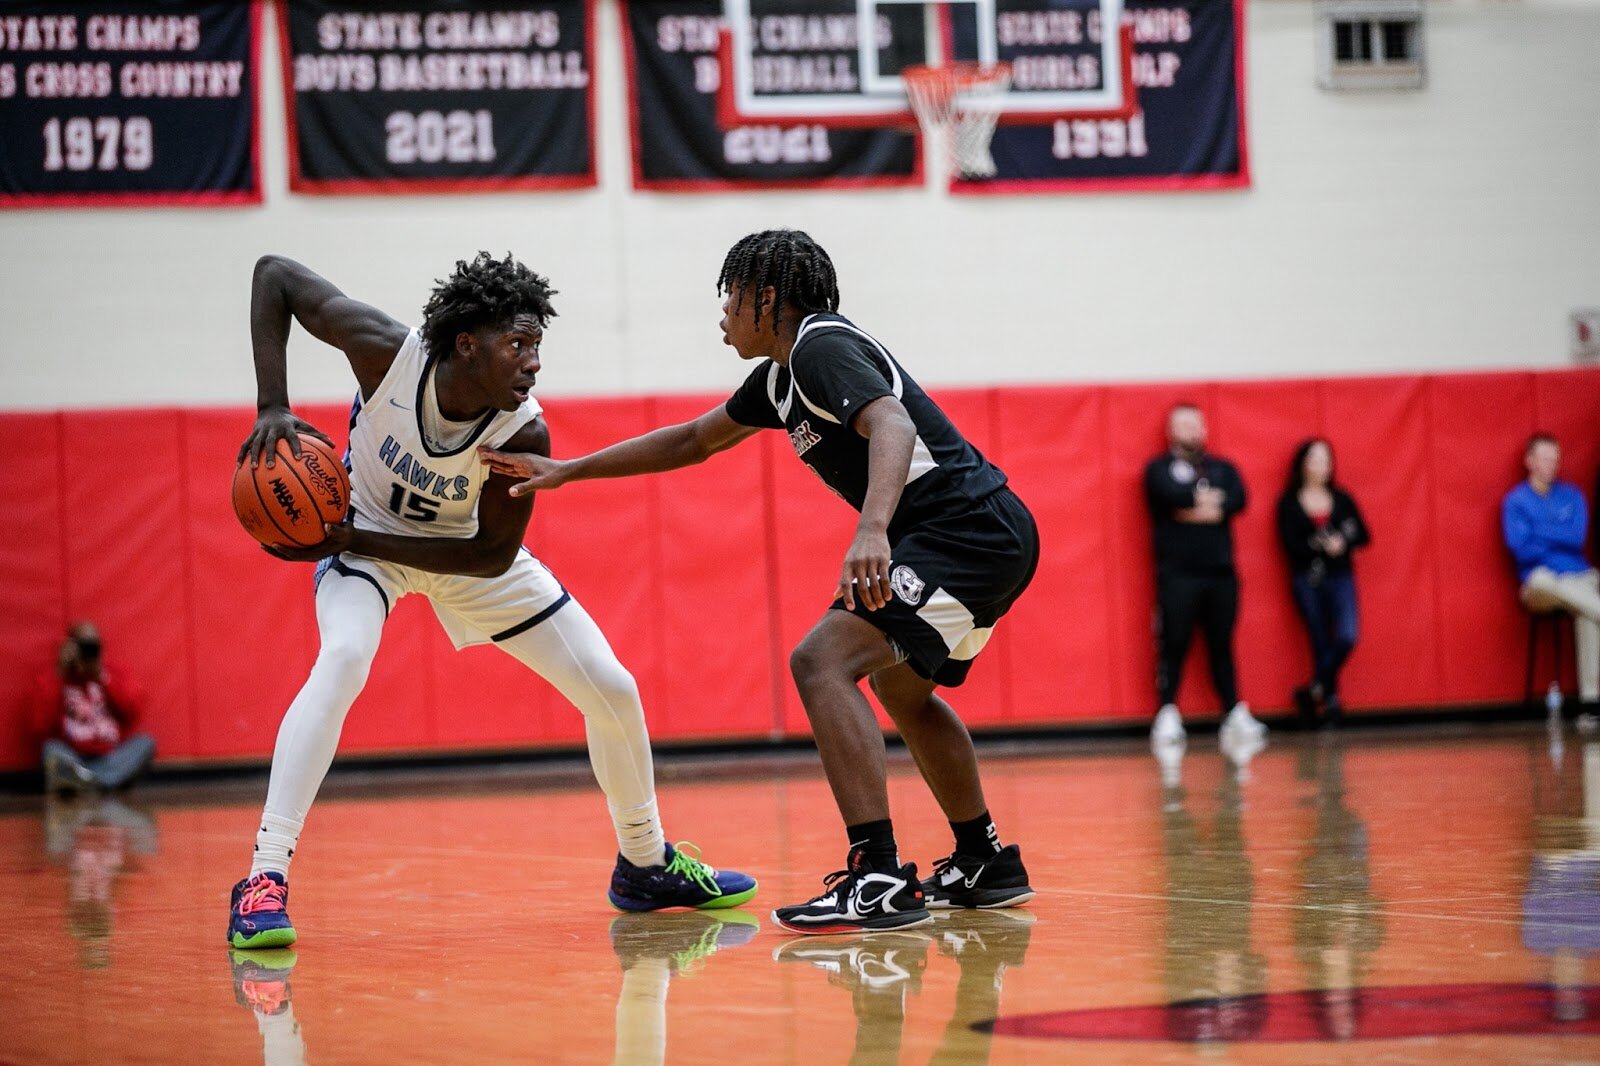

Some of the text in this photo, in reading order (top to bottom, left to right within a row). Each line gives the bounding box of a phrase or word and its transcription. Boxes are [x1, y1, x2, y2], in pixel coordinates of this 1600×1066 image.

[0, 15, 200, 50] TATE CHAMPS
[318, 11, 559, 49] STATE CHAMPS
[26, 61, 112, 98] CROSS
[120, 60, 243, 97] COUNTRY
[294, 52, 589, 91] BOYS BASKETBALL
[1012, 54, 1099, 89] GIRLS
[43, 116, 152, 170] 1979
[385, 109, 496, 163] 2021
[301, 450, 343, 512] Rawlings
[379, 434, 469, 501] HAWKS
[390, 481, 441, 521] 15
